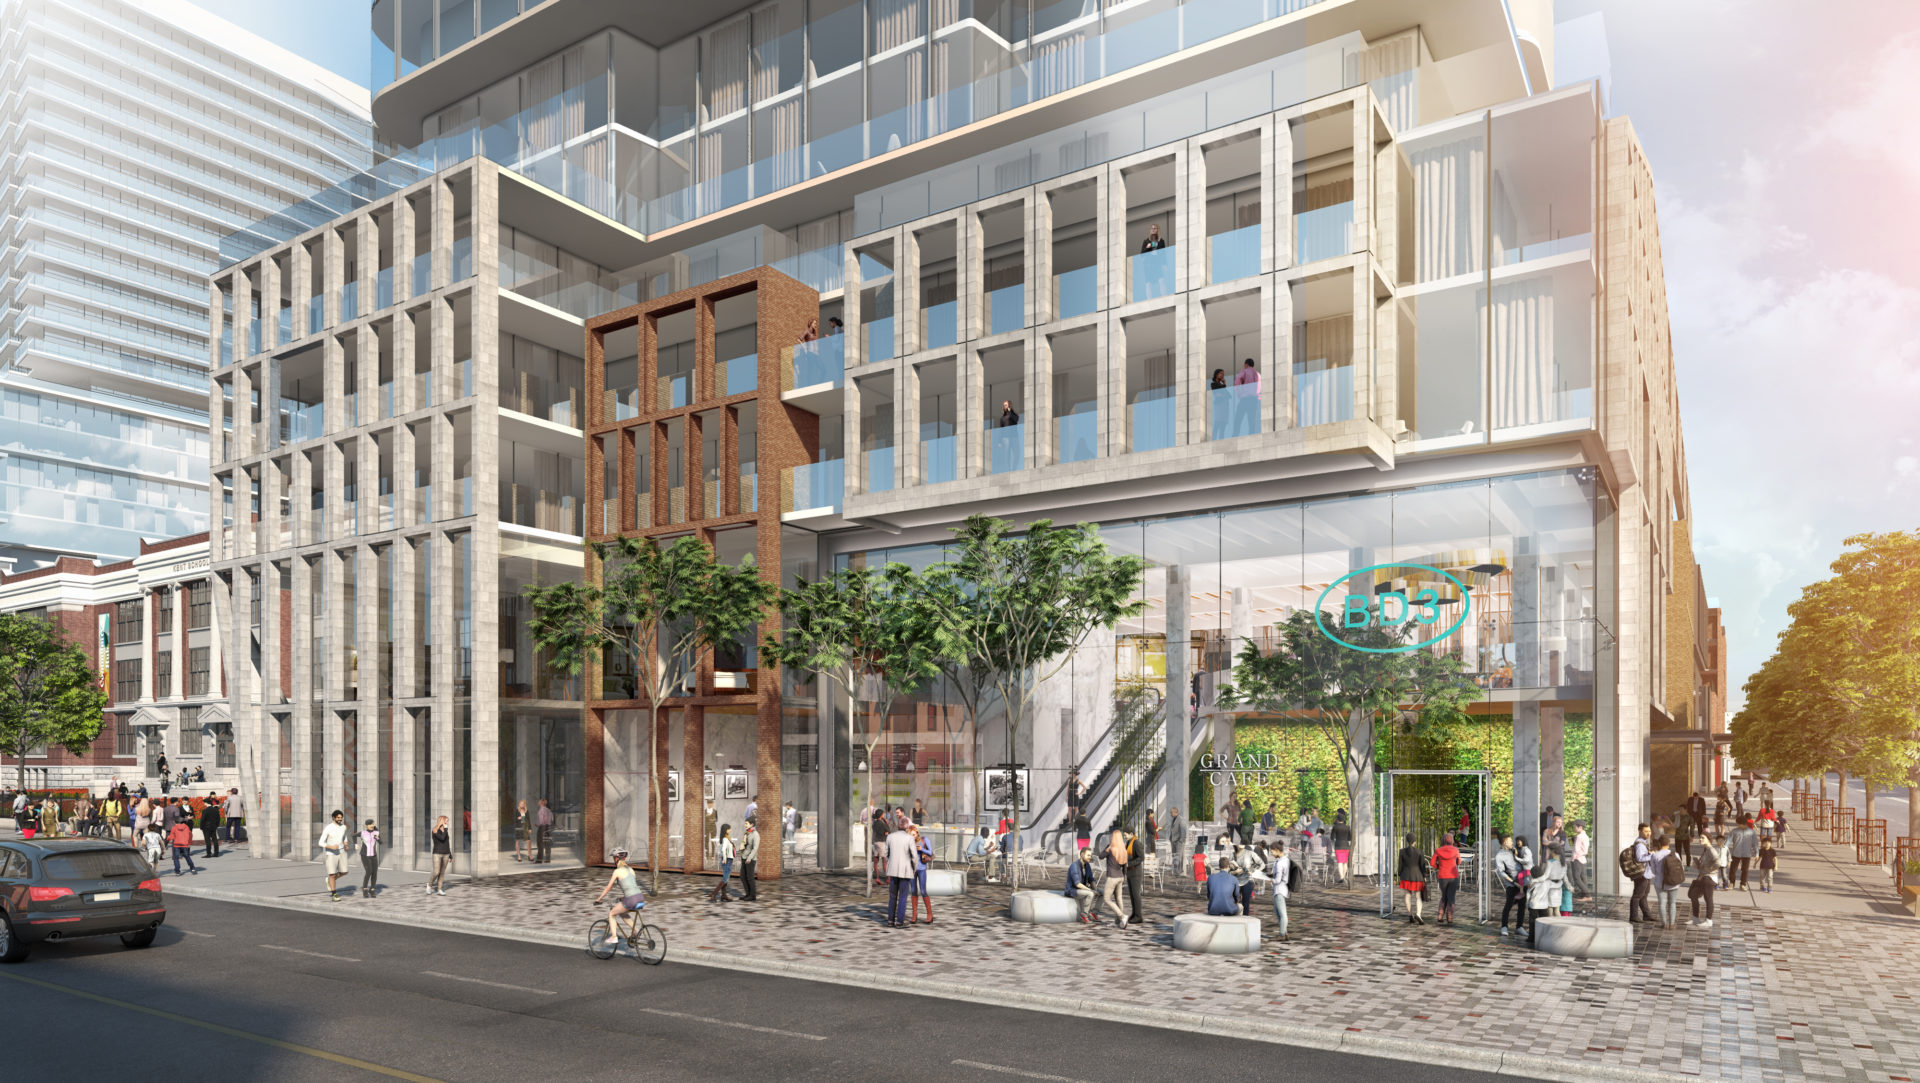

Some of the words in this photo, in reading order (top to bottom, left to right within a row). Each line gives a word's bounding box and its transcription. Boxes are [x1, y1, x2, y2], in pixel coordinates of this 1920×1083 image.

[1344, 588, 1441, 628] BD3
[1200, 753, 1278, 768] GRAND
[1210, 772, 1269, 786] CAFE
